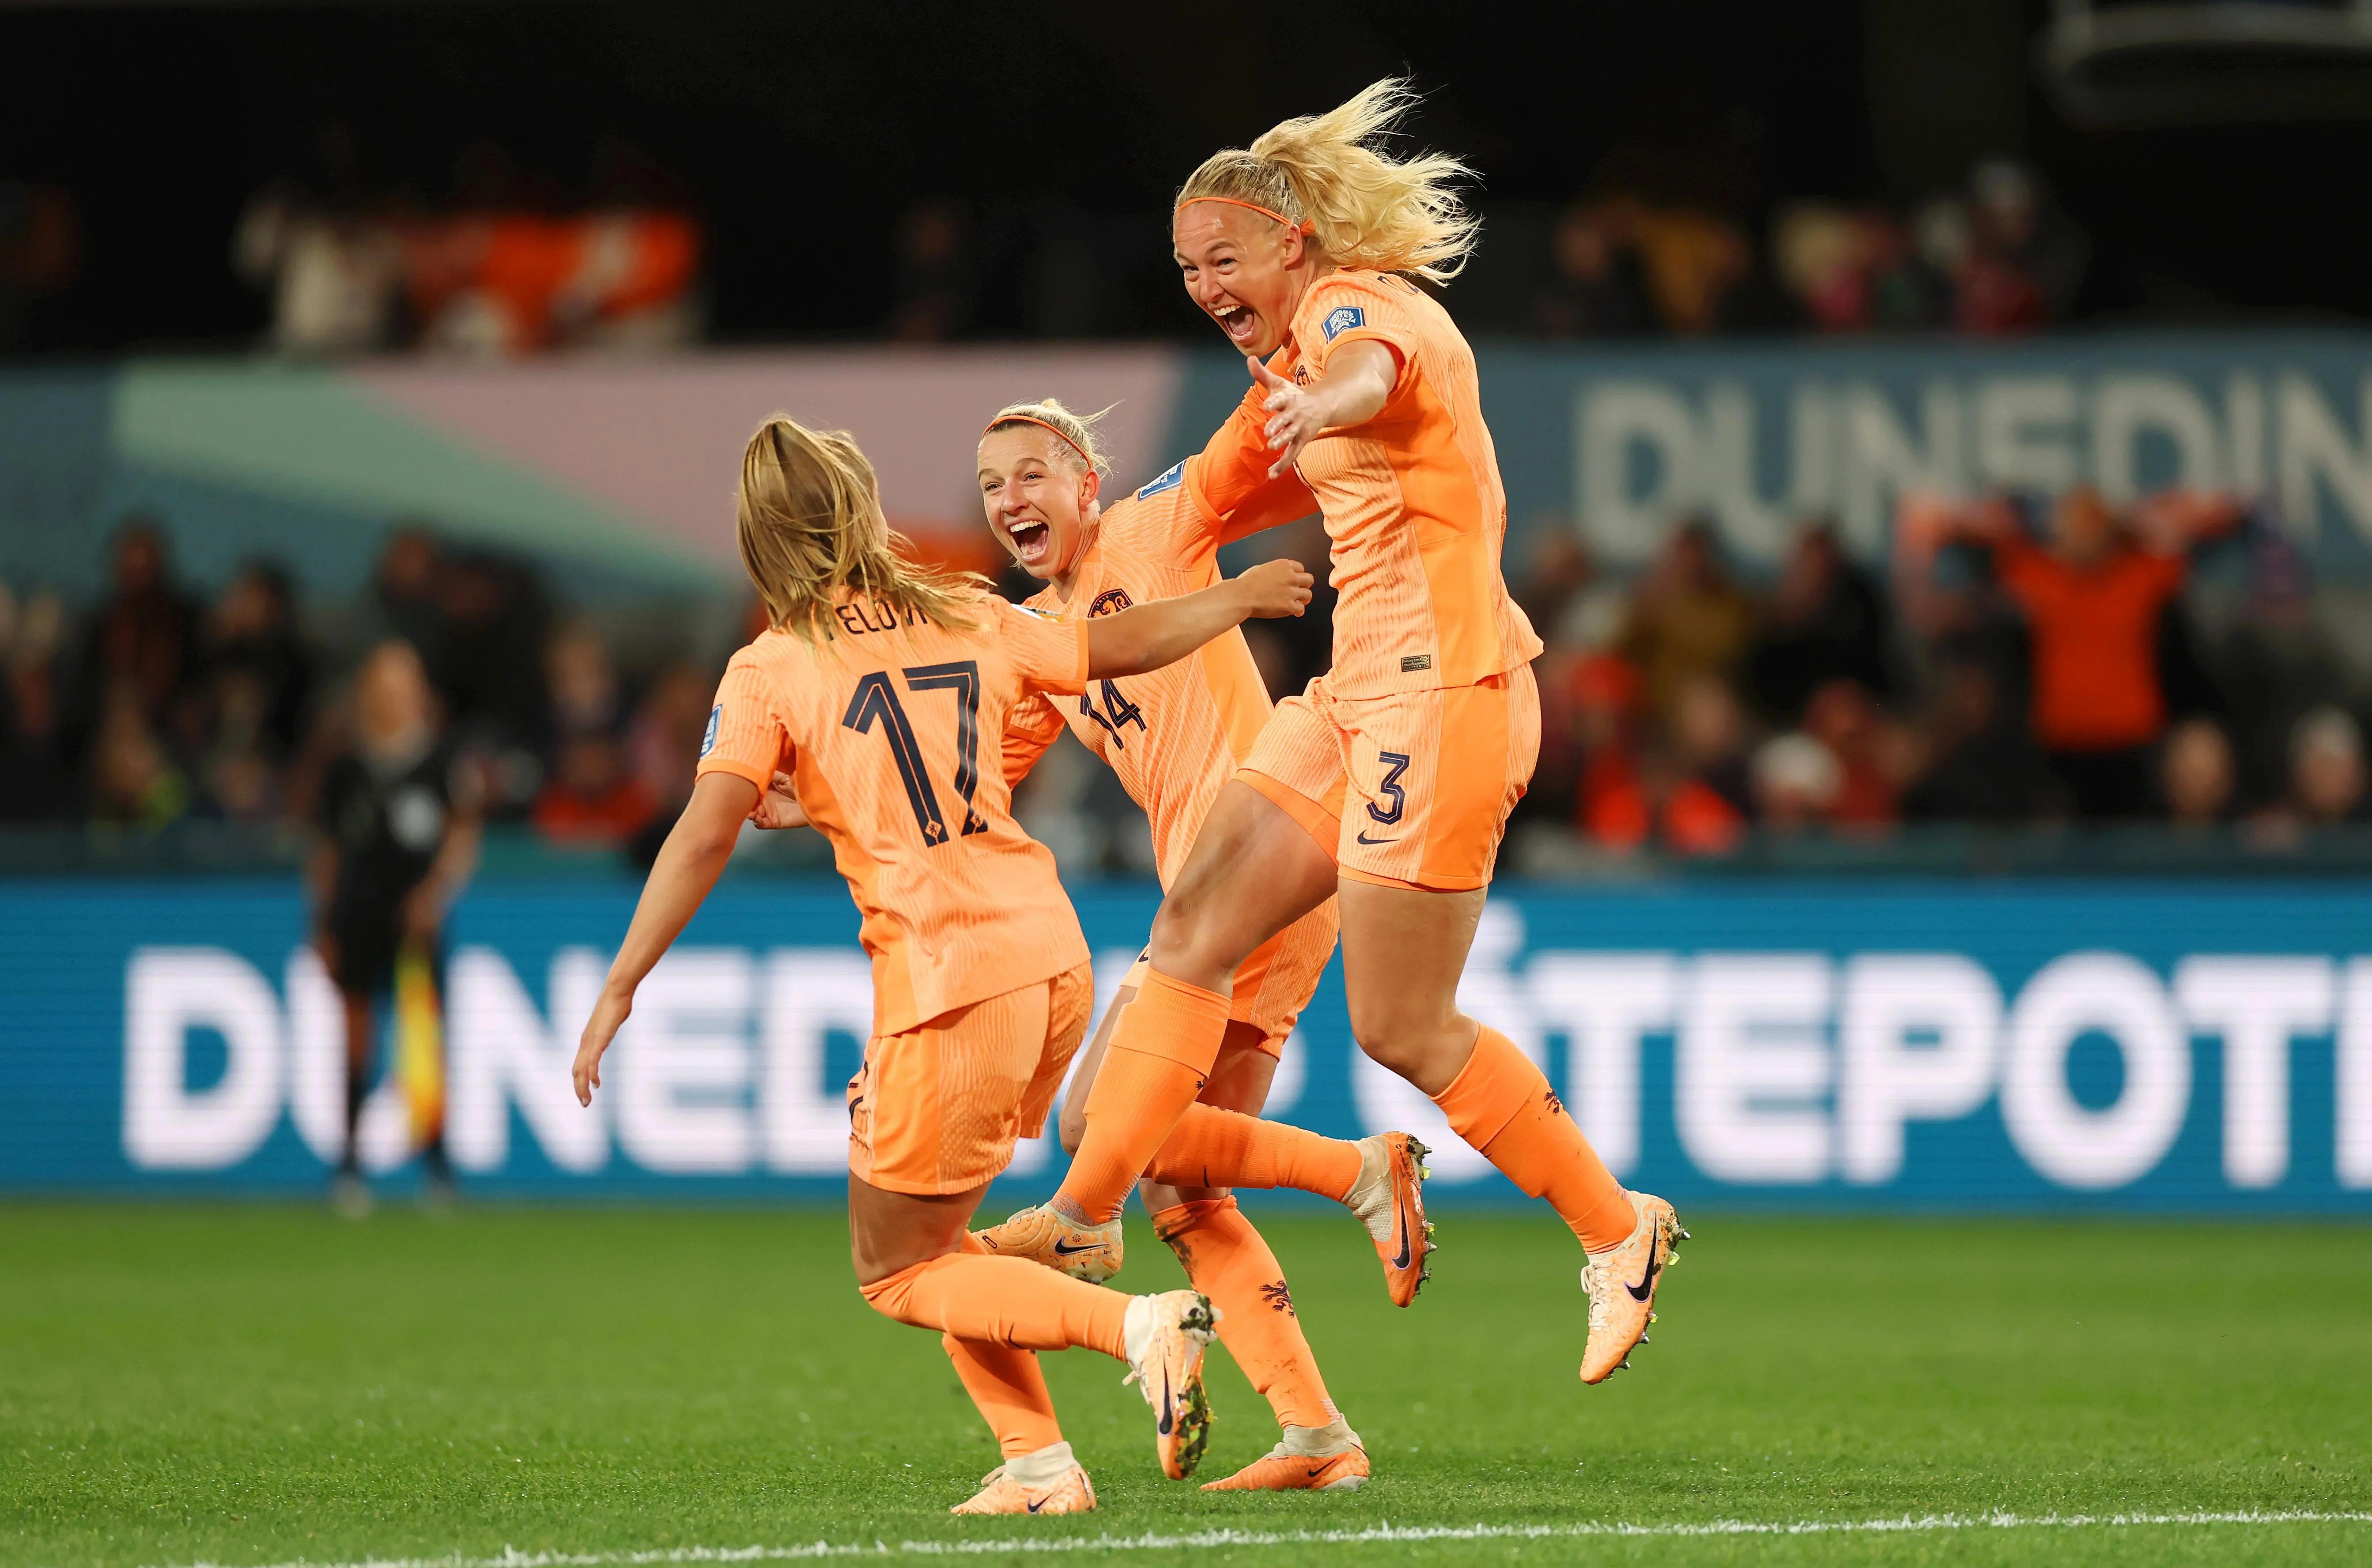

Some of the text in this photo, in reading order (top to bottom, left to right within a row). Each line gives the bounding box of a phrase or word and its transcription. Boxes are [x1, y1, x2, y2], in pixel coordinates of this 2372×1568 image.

[1080, 678, 1147, 750] 14
[842, 660, 988, 848] 17
[1367, 751, 1410, 825] 3
